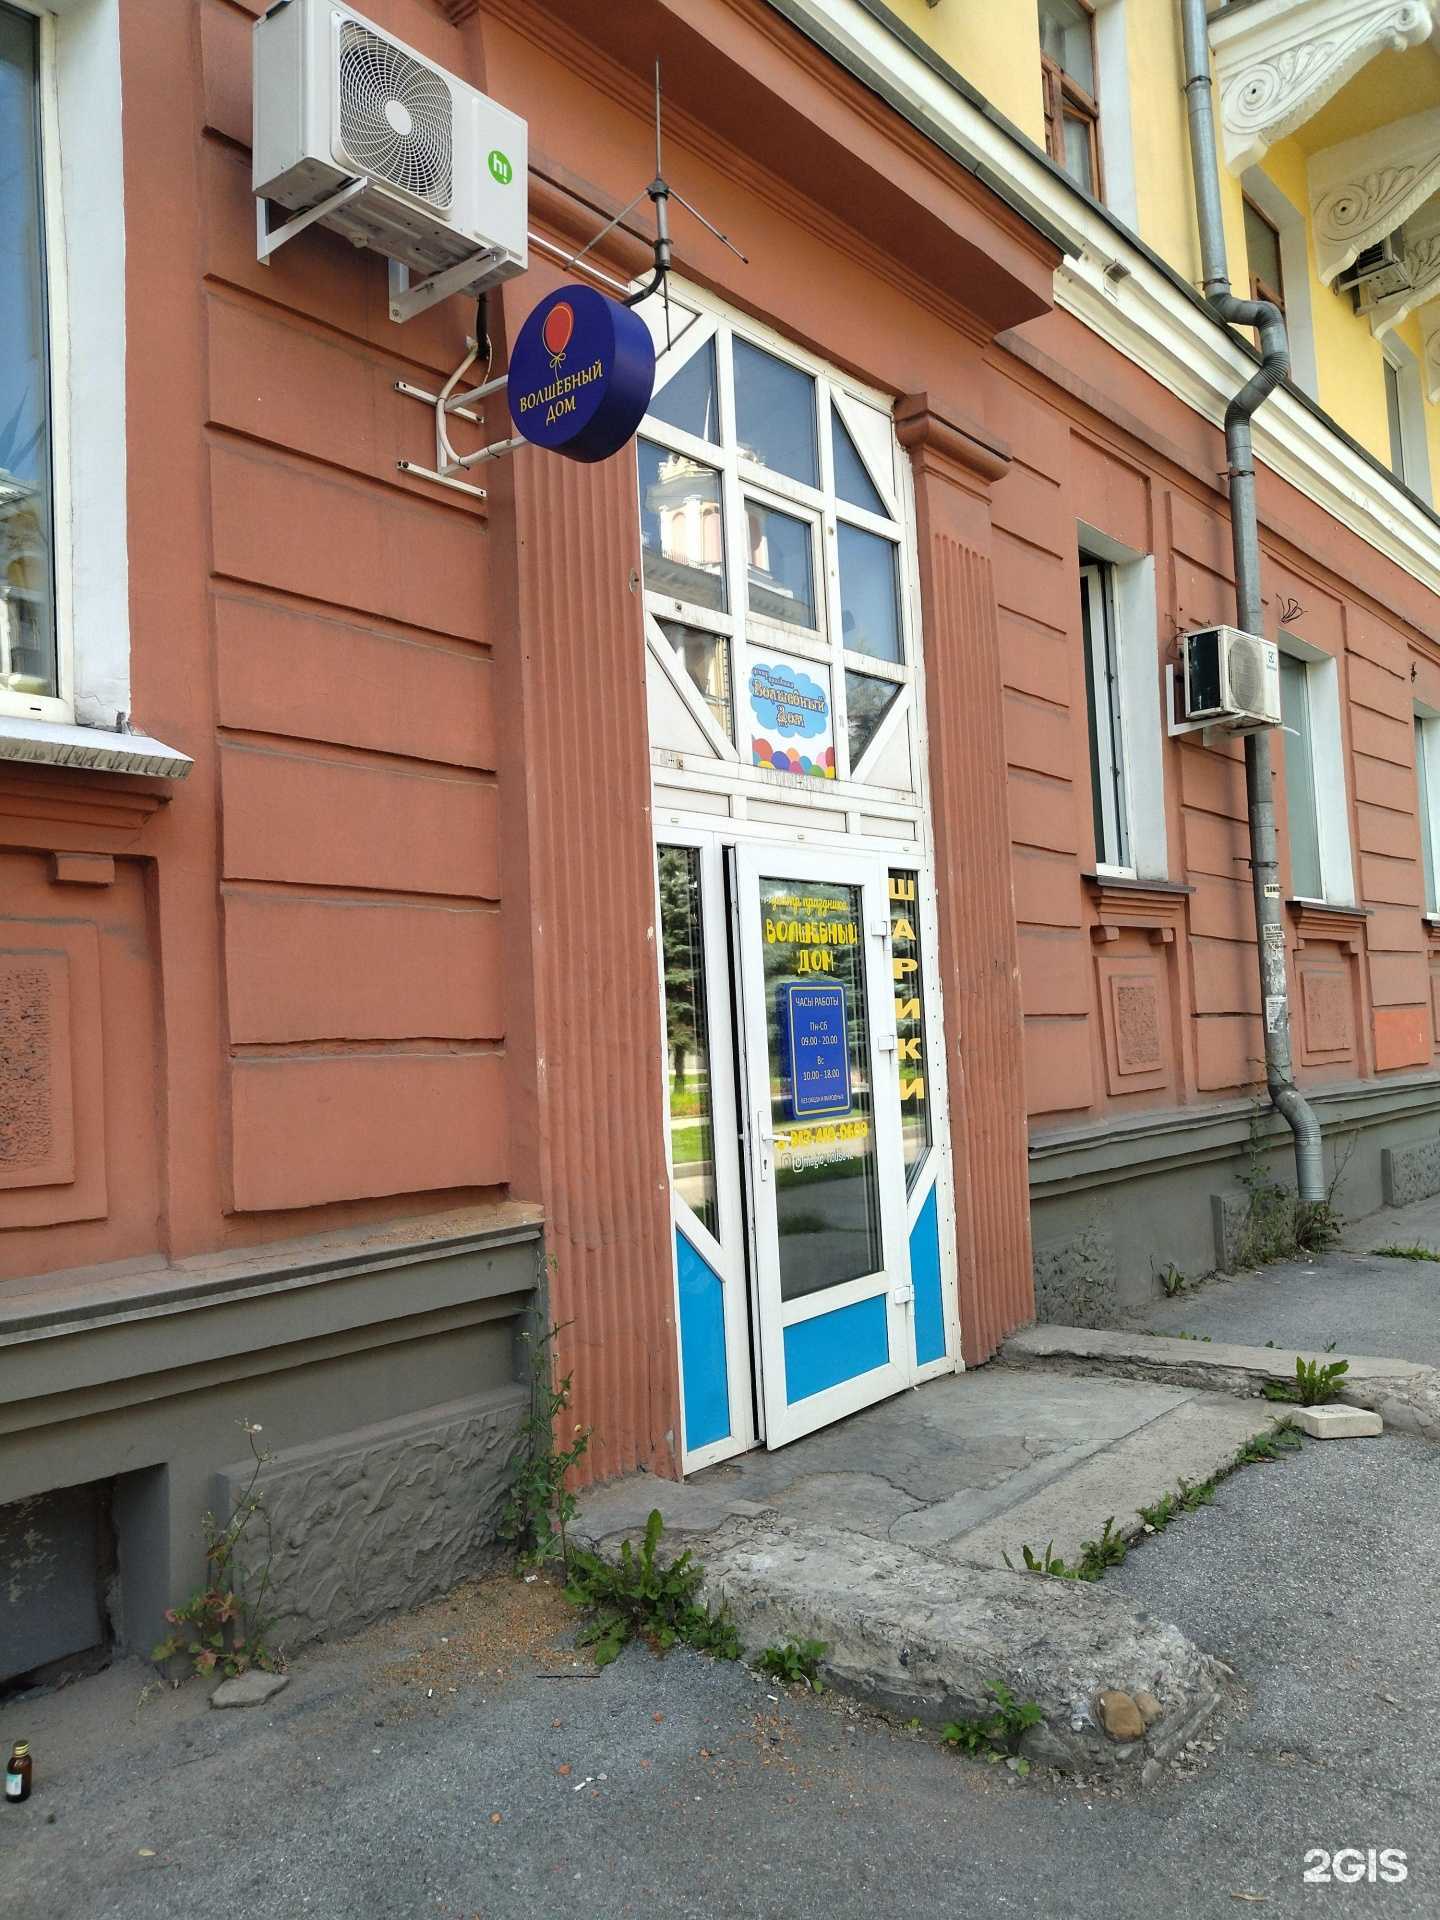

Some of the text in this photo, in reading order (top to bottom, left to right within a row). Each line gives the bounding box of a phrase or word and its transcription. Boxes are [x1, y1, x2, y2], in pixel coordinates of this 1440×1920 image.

[519, 359, 603, 413] ВОЛШЕБНЫЙ
[546, 396, 576, 426] ДОМ
[766, 918, 858, 945] ВОЛШЕБНЫЙ
[798, 948, 834, 974] ДОМ
[795, 996, 839, 1007] ЧАСЫ РАБОТЫ
[888, 877, 924, 1100] ШАРИКИ
